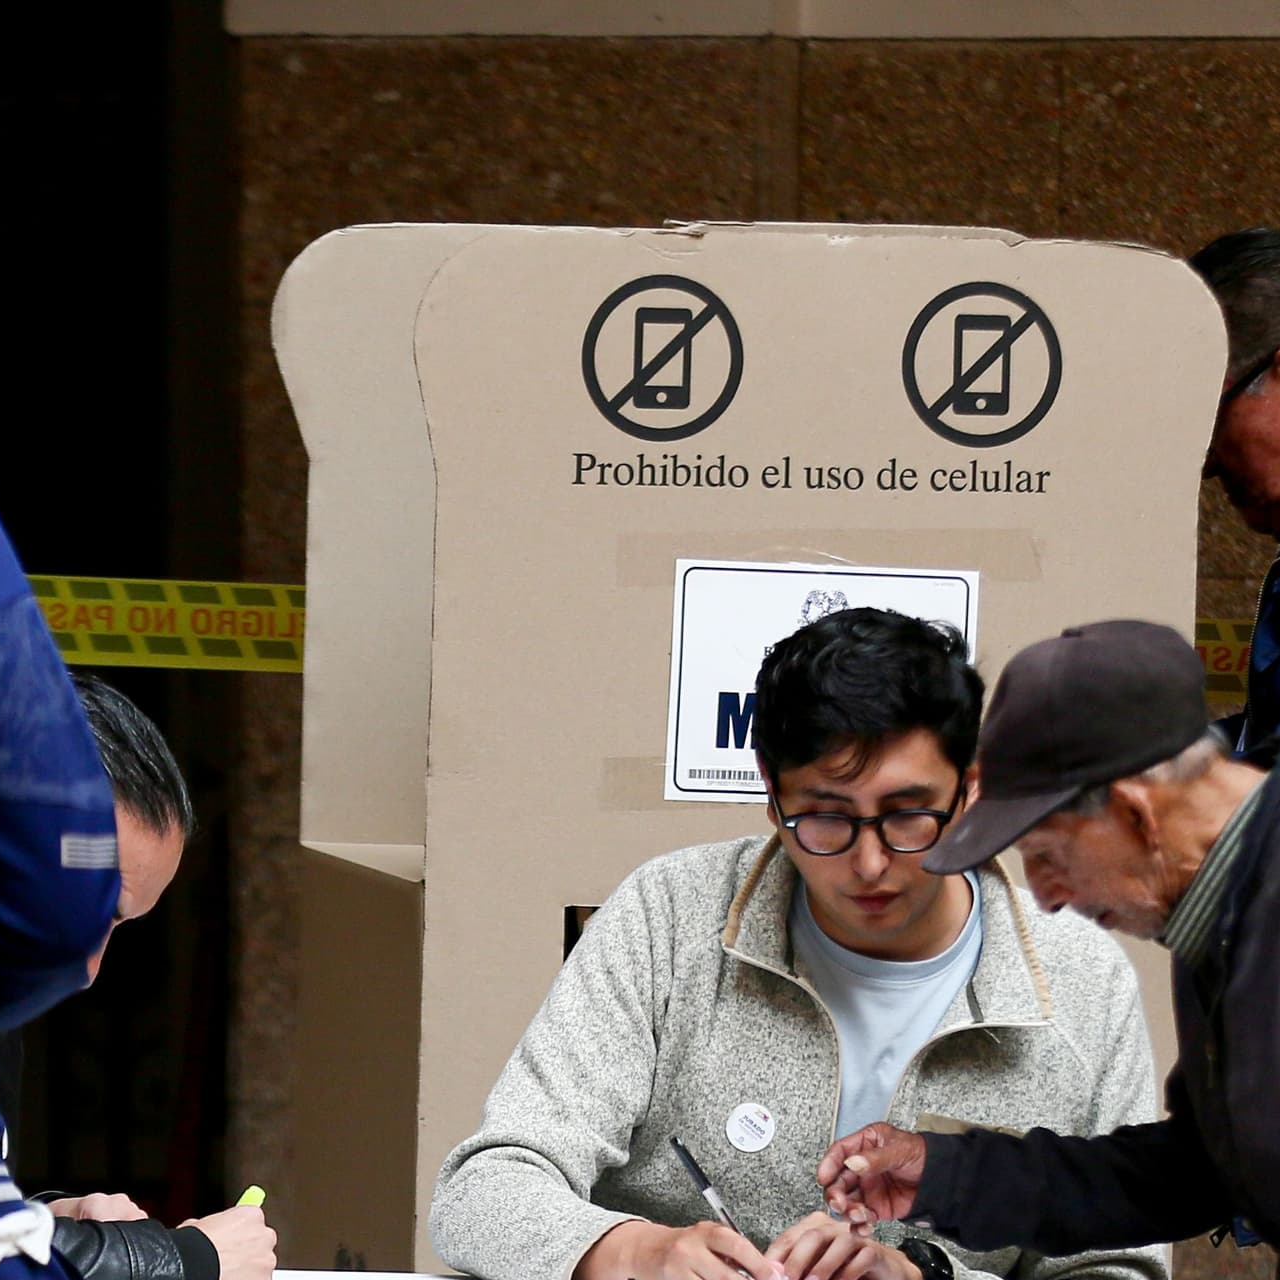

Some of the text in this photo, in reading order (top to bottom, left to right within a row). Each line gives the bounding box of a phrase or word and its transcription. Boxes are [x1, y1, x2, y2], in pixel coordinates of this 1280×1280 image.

[572, 453, 1051, 494] Prohibido el uso de celular
